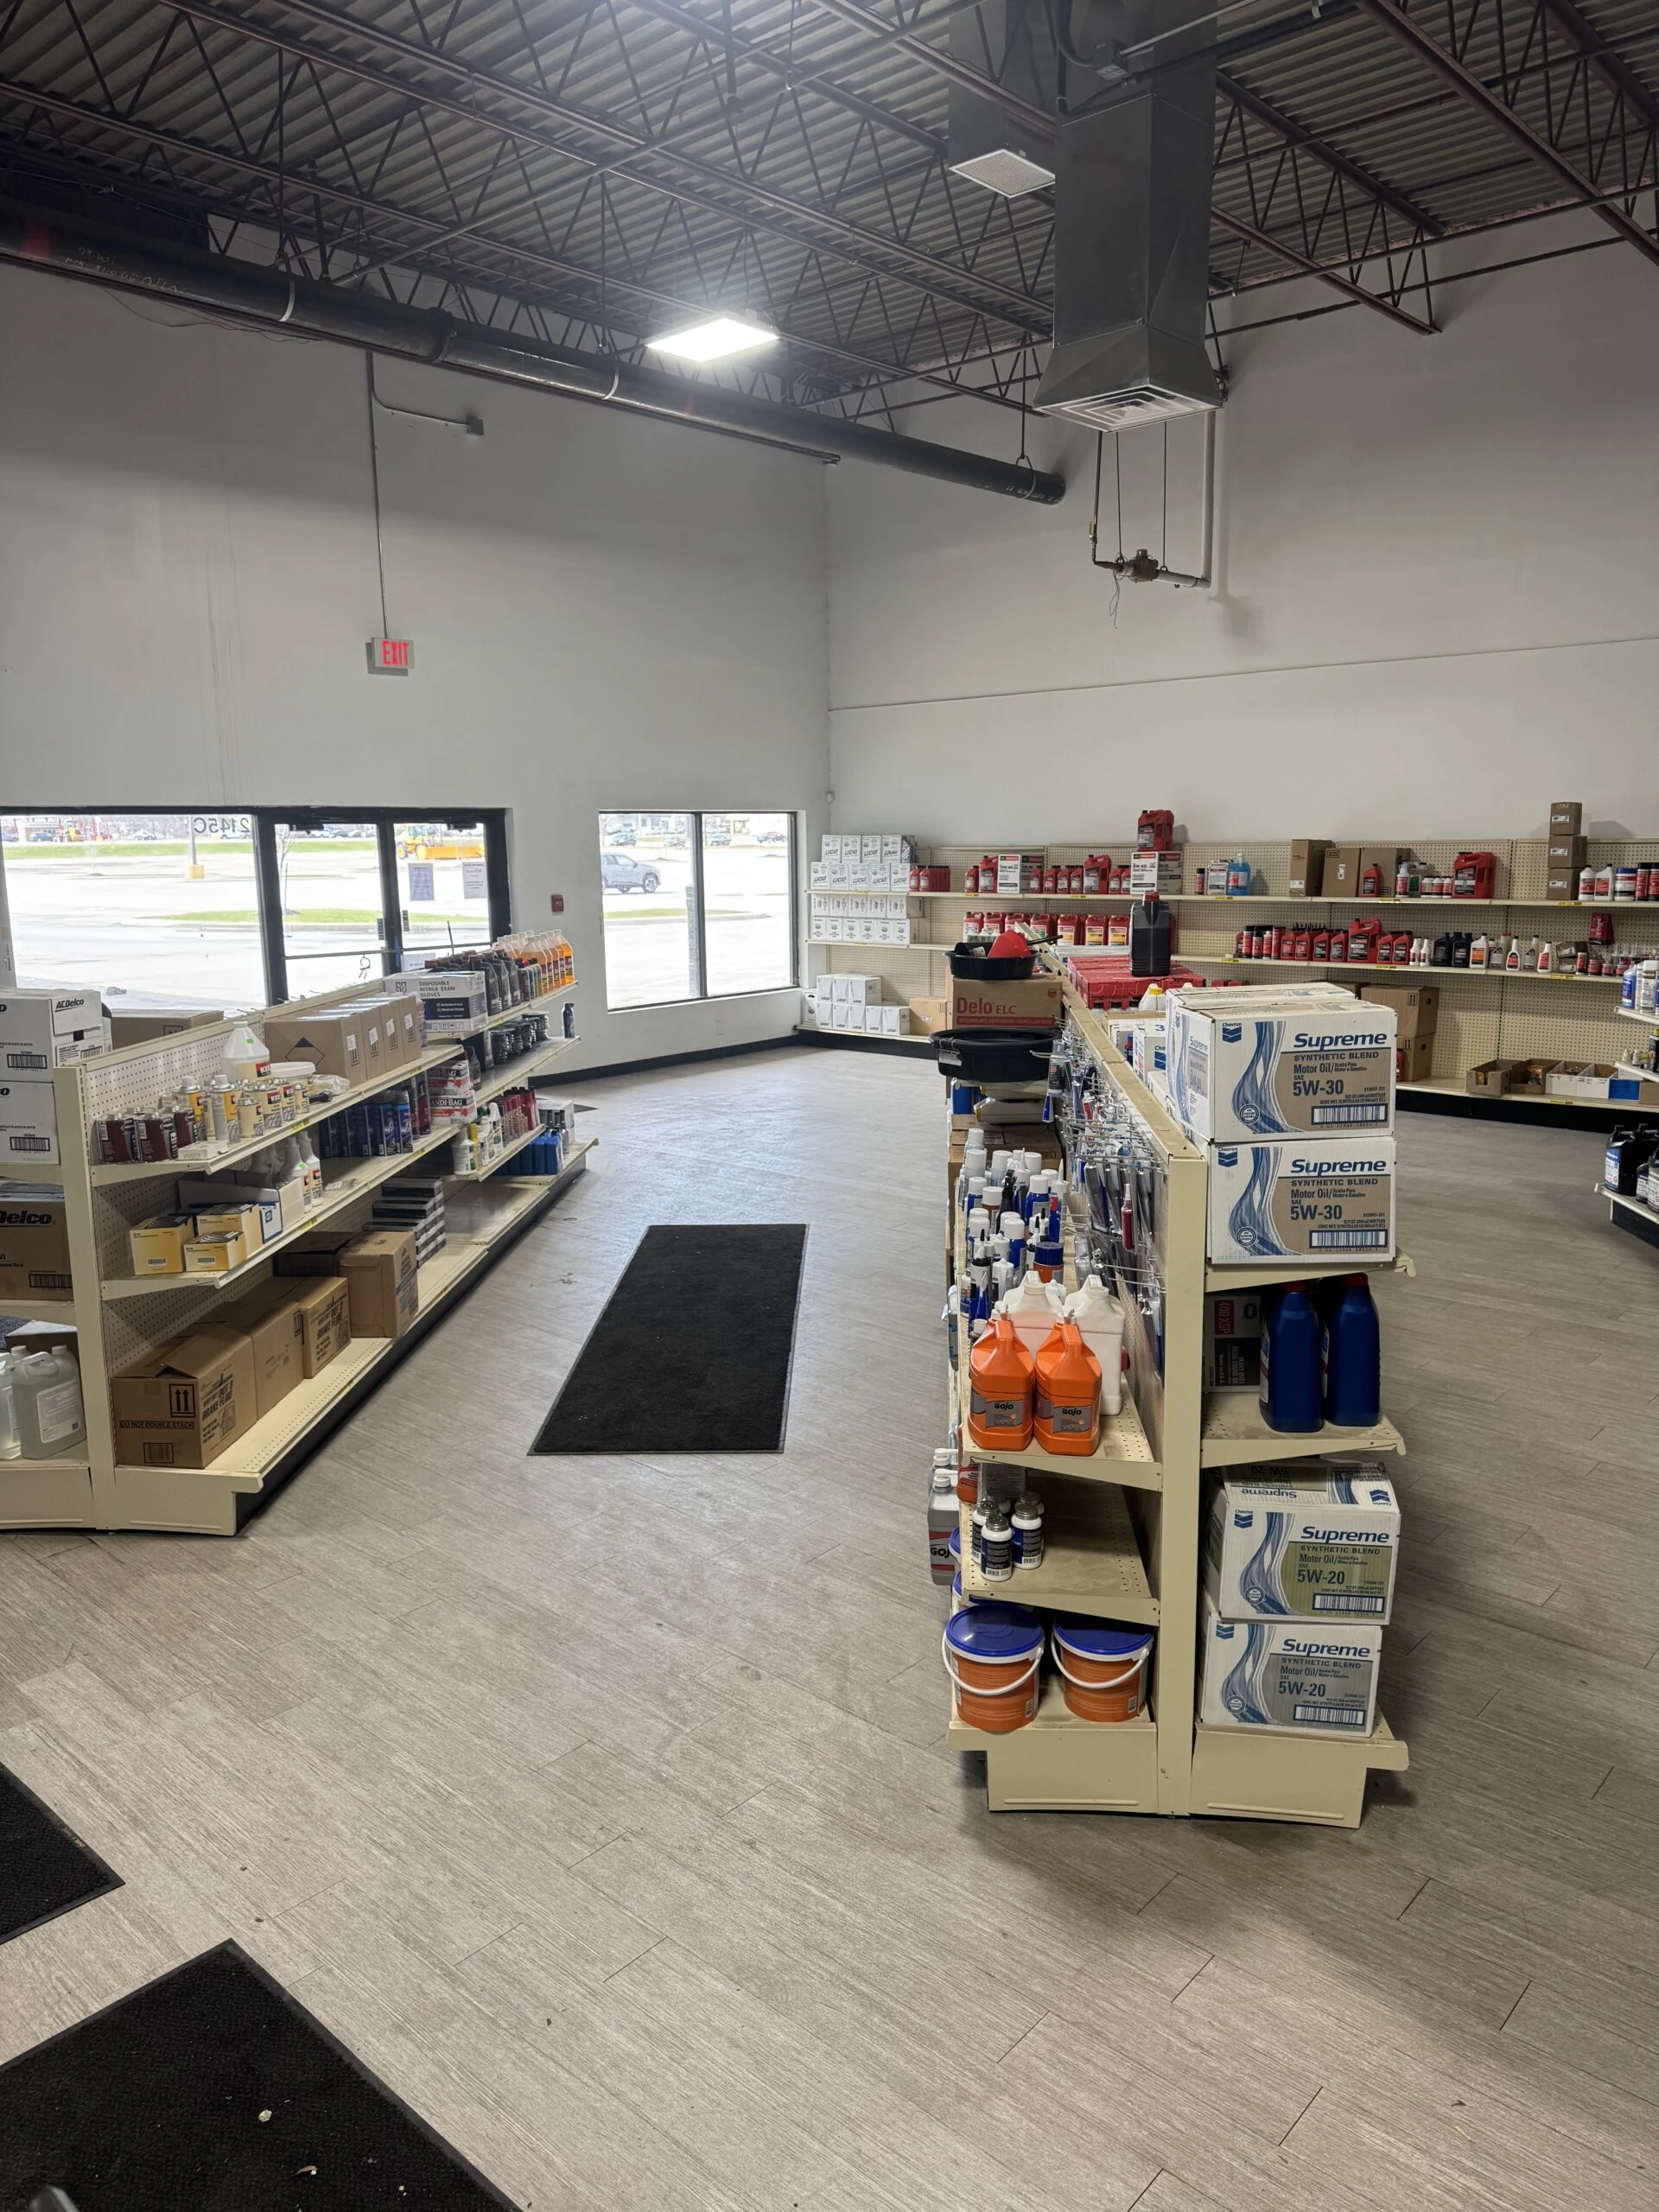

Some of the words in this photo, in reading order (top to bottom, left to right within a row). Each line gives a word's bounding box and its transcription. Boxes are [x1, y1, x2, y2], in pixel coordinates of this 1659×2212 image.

[381, 640, 409, 666] EXIT
[56, 998, 84, 1009] ACDelco
[956, 997, 992, 1014] Delo
[996, 1004, 1017, 1014] ELC
[1190, 1036, 1208, 1053] Supreme
[1294, 1033, 1387, 1051] Supreme
[1294, 1053, 1346, 1061] SYNTHETIC
[1294, 1064, 1317, 1074] Motor
[1293, 1080, 1344, 1096] 5W-30
[1290, 1159, 1386, 1177] Supreme
[1291, 1189, 1315, 1199] Motor
[1290, 1205, 1342, 1220] 5W-30
[202, 1402, 219, 1421] BRAKE
[994, 1402, 1014, 1410] GOJO
[1062, 1407, 1082, 1416] GOJO
[1241, 1488, 1297, 1499] Supreme
[1301, 1526, 1389, 1544] Supreme
[1299, 1554, 1322, 1563] Motor
[1297, 1569, 1345, 1585] 5W-20
[1282, 1638, 1370, 1657] Supreme
[1282, 1658, 1329, 1666] SYNTHETIC
[1280, 1666, 1303, 1675] Motor
[1279, 1681, 1326, 1697] 5W-20
